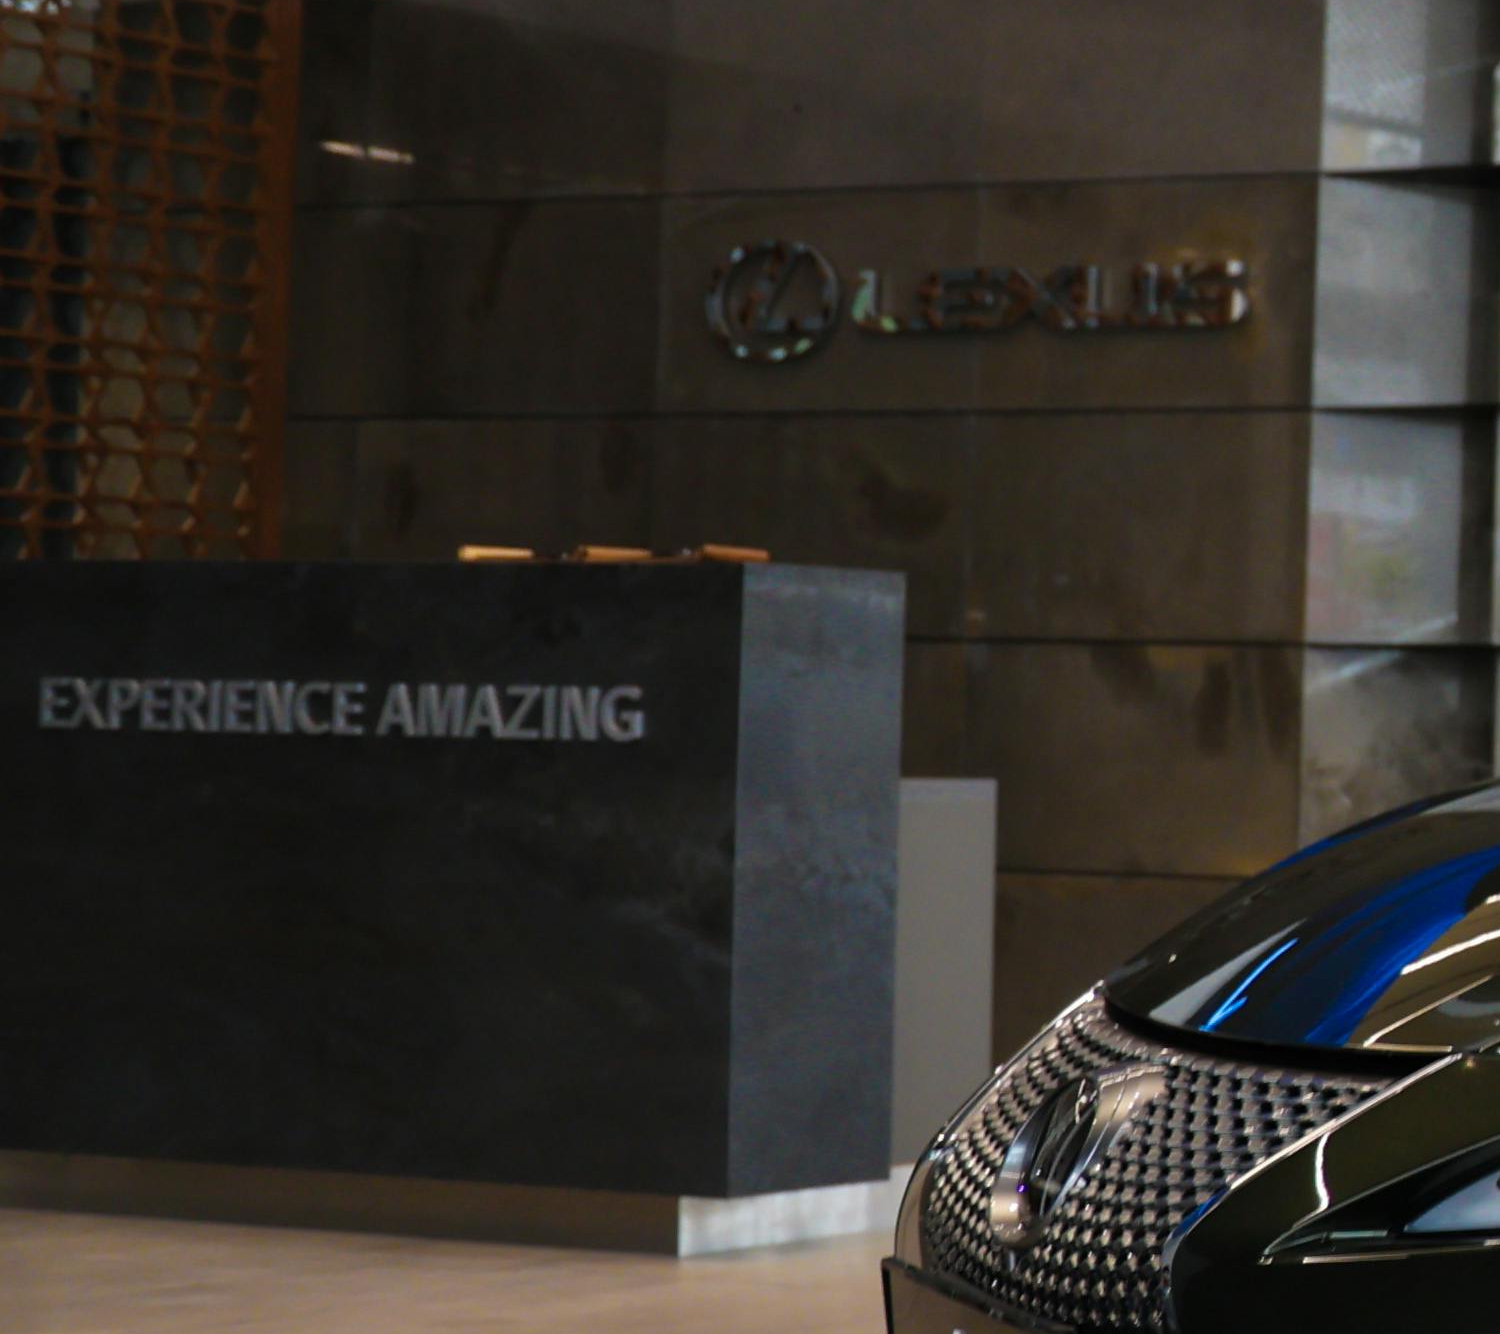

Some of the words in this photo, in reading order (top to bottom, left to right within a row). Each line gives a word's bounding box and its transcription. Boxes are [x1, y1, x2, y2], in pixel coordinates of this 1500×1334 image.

[849, 260, 1251, 333] LEXUS
[38, 677, 366, 735] EXPERIENCE
[377, 682, 647, 742] AMAZING
